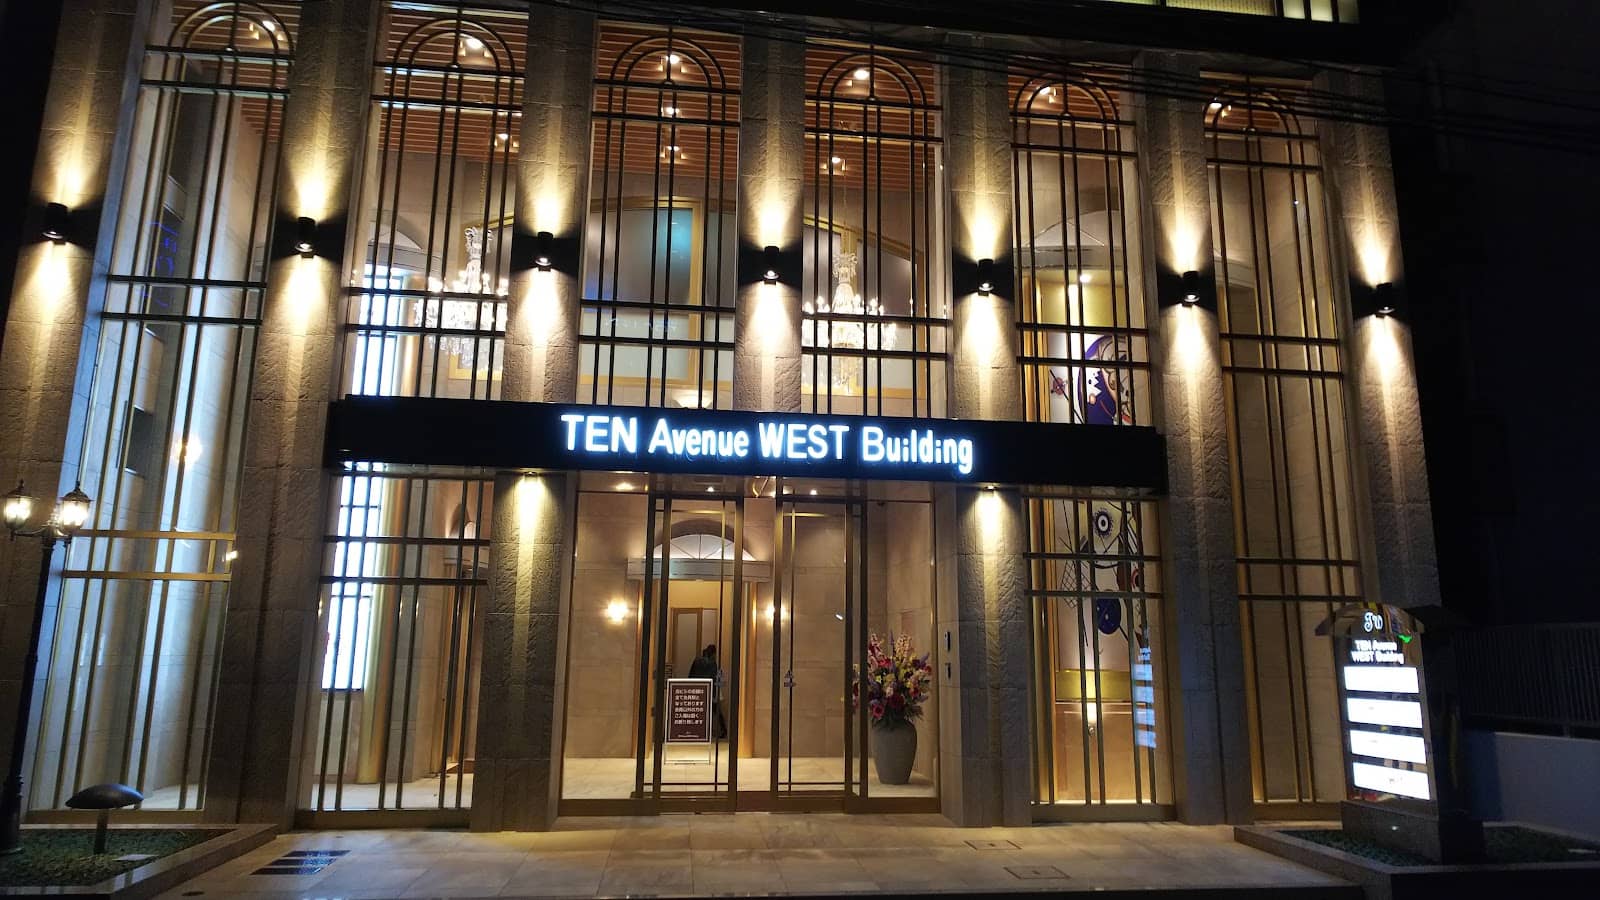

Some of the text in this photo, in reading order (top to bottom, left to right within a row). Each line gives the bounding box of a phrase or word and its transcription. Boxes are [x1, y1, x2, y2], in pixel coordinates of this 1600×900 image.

[560, 414, 974, 475] TEN Avenue WEST Building
